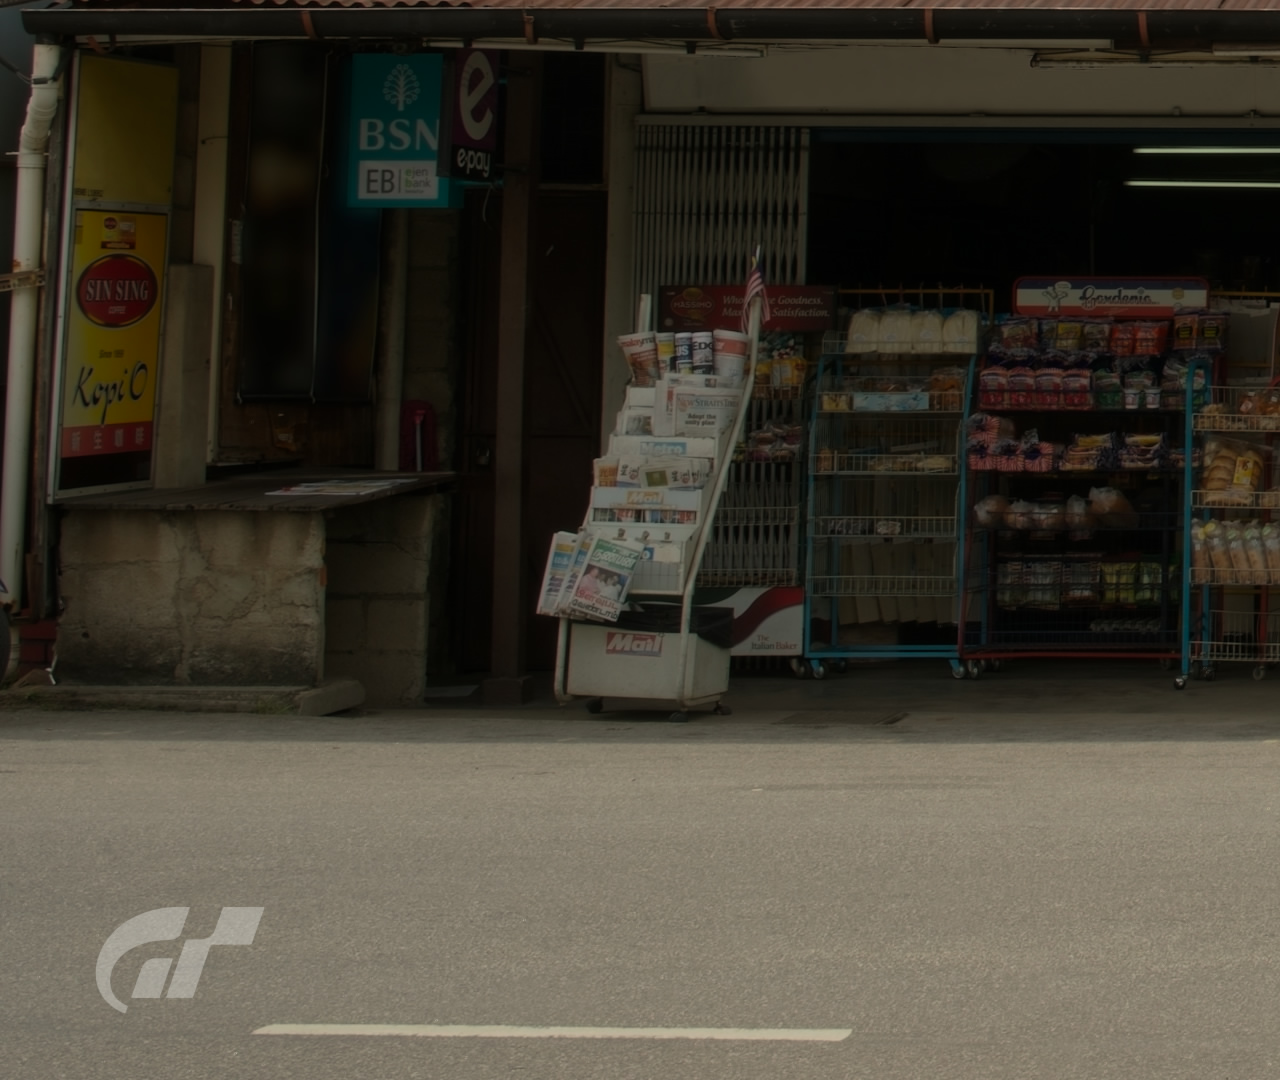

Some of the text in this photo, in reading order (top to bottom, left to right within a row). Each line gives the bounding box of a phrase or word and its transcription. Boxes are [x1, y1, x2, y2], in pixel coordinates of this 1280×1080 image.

[359, 118, 439, 151] BSN
[366, 169, 395, 193] EB
[405, 167, 429, 179] ejen
[405, 178, 431, 188] bank
[86, 280, 149, 301] SIN SING
[1080, 286, 1152, 306] Gardenia
[673, 301, 712, 309] MASSIMO
[777, 296, 824, 306] Goodness.
[772, 307, 831, 319] Satisfaction.
[72, 361, 149, 425] Kopi O
[607, 633, 662, 653] Mail
[751, 641, 798, 650] Italian Baker
